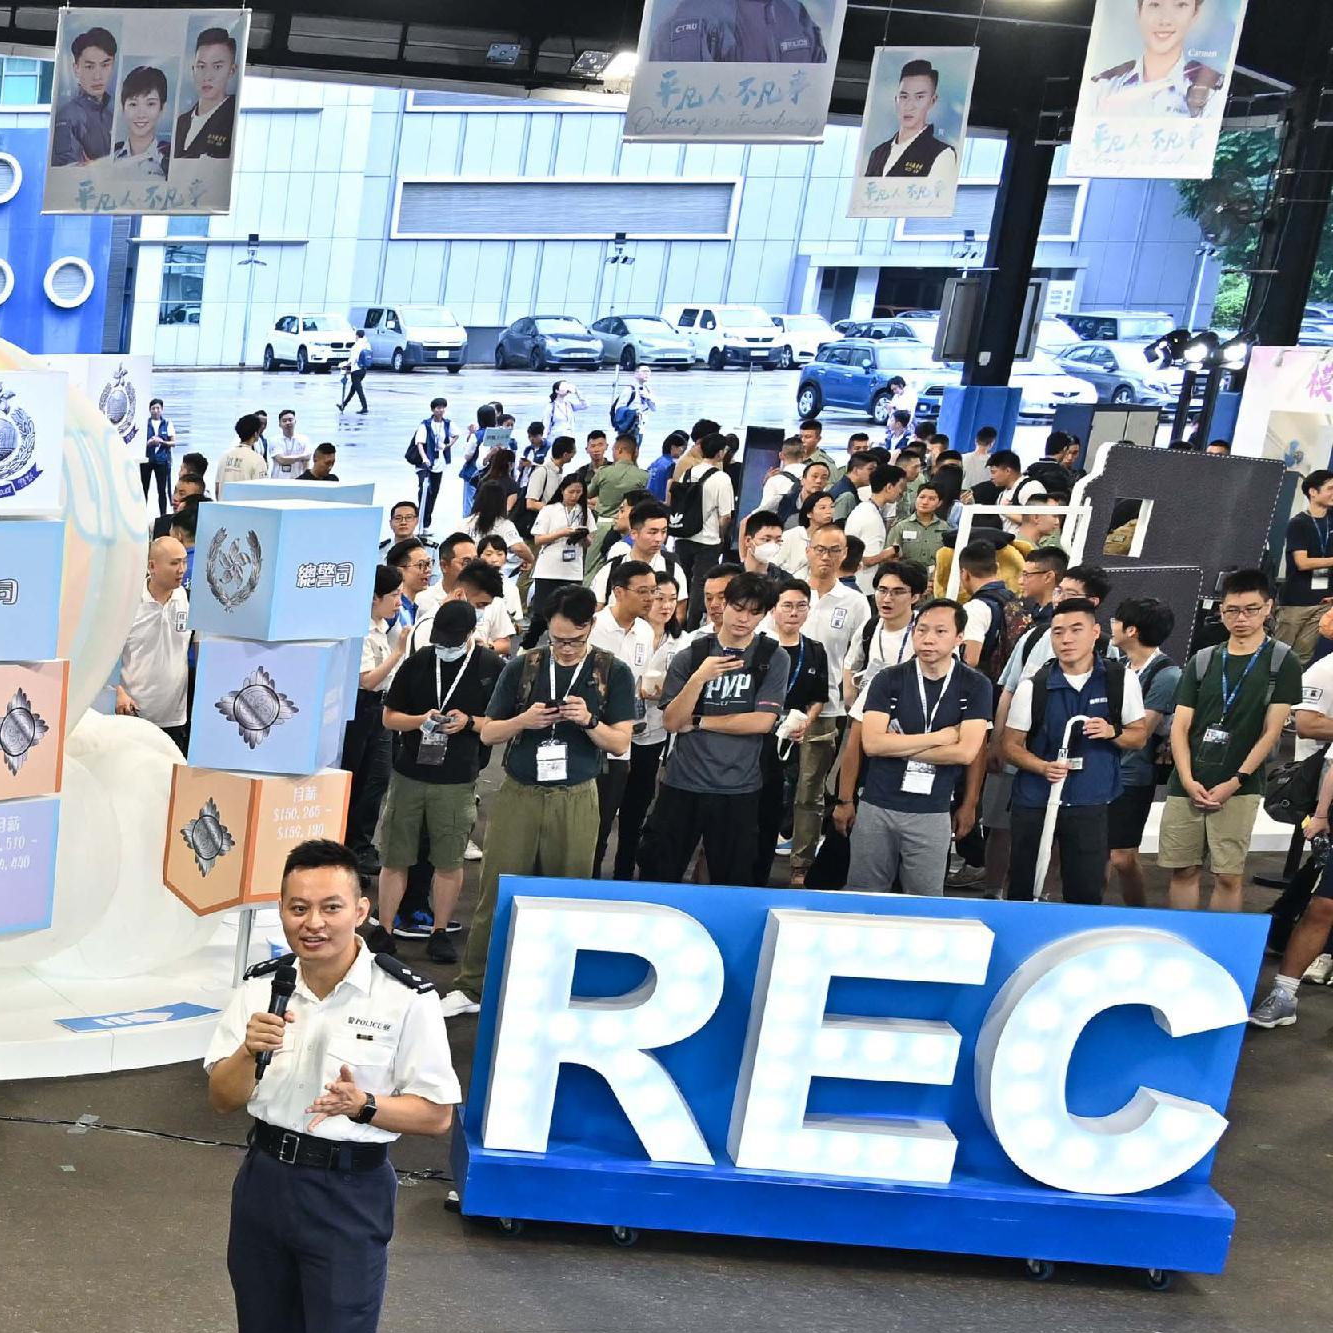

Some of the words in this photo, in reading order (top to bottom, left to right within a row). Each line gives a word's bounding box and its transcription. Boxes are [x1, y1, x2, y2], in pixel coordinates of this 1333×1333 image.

[296, 561, 354, 588] 總警司
[482, 895, 1249, 1194] REC
